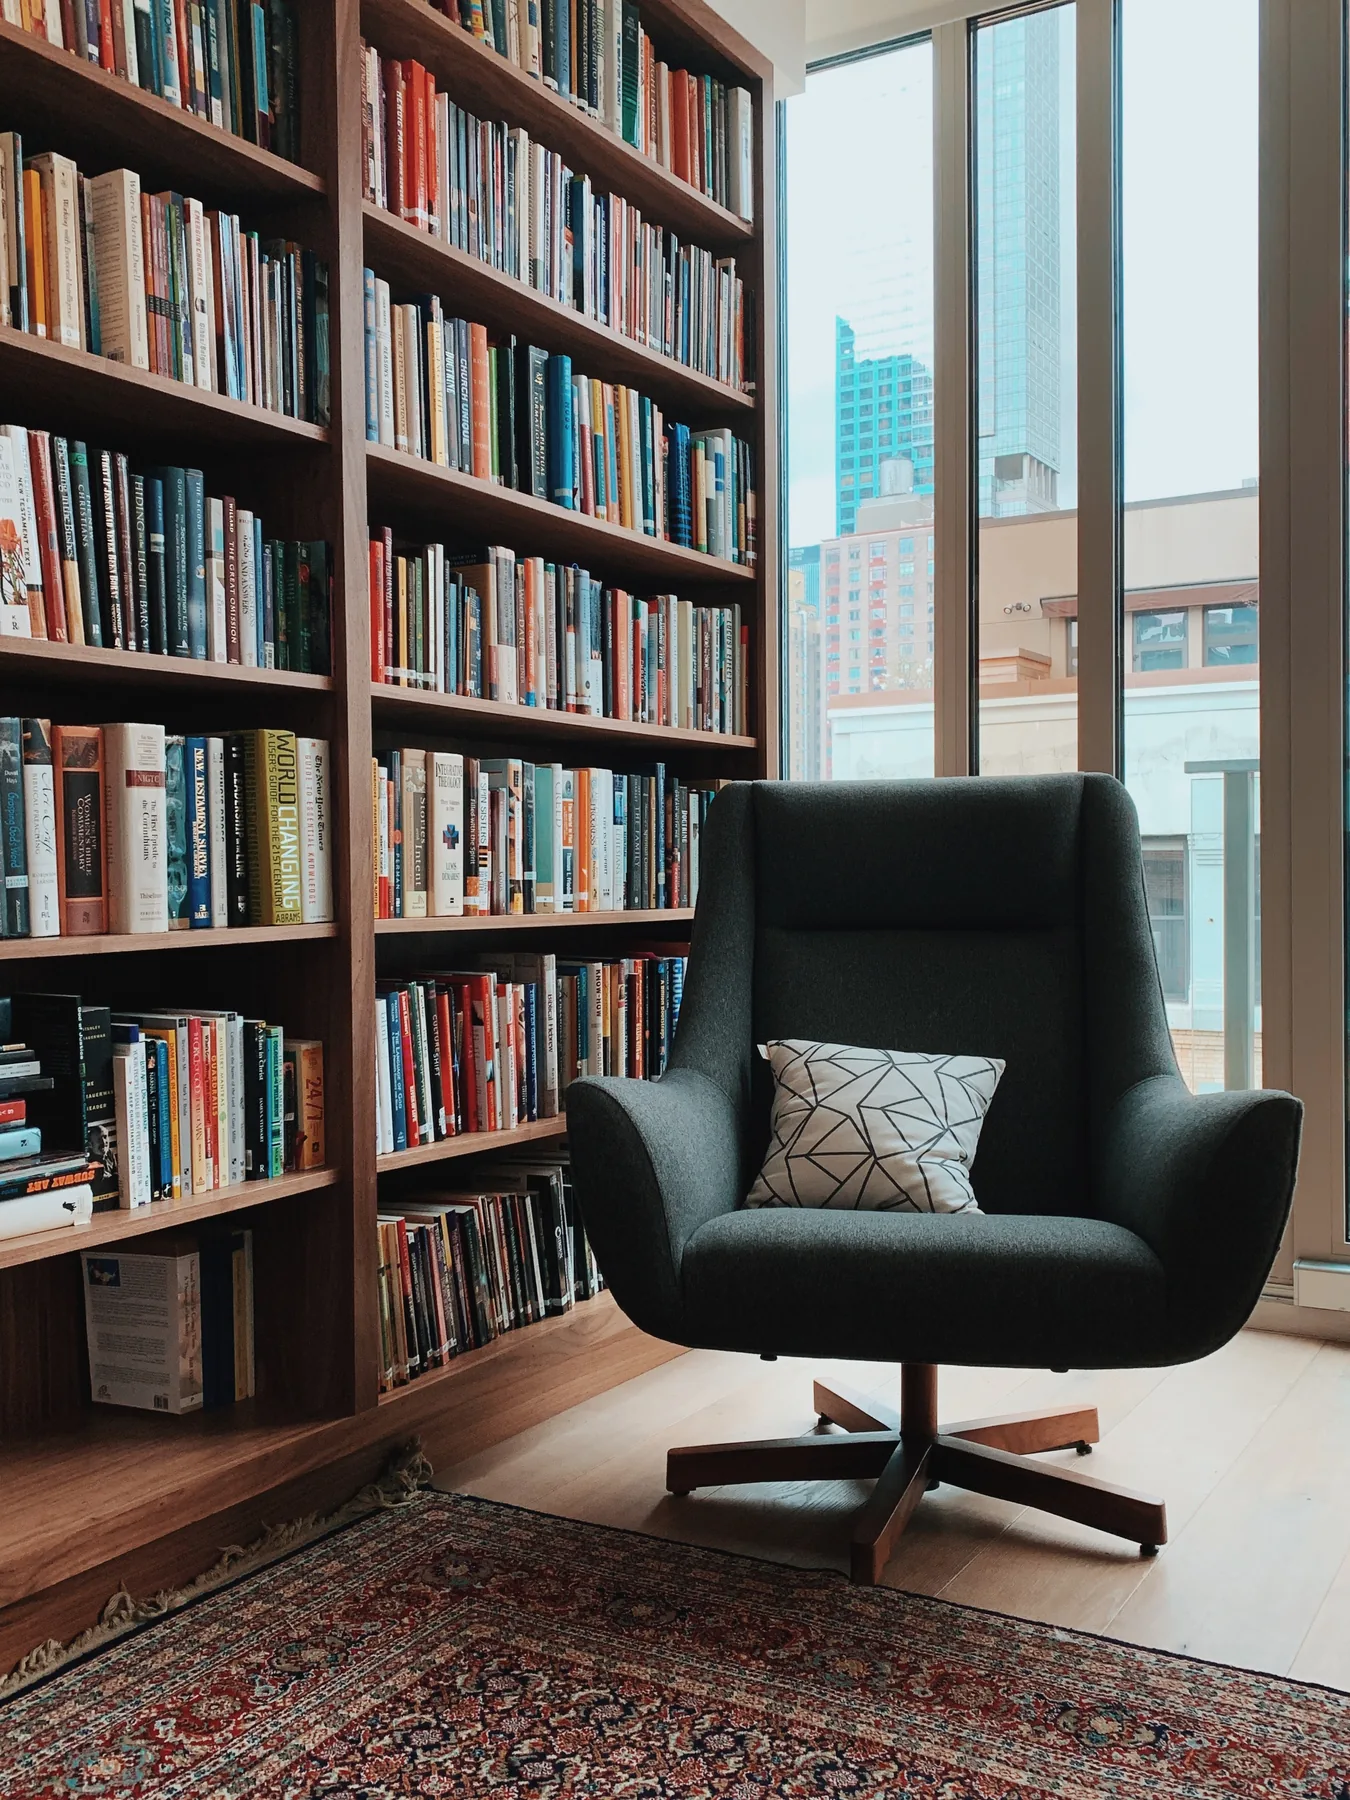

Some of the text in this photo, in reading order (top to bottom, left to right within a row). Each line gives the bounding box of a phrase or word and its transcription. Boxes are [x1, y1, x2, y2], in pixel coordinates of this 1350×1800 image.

[129, 180, 140, 282] Where Mortals Dwell
[195, 248, 203, 286] CHURCHES
[445, 351, 455, 394] DOCTRINE
[460, 358, 468, 400] CHURCH
[58, 462, 70, 492] Thing
[101, 454, 109, 475] WHAT
[62, 494, 70, 504] in
[103, 488, 112, 511] JESUS
[19, 498, 28, 543] TESTAMENT
[63, 504, 72, 523] the
[78, 484, 89, 547] CHRISTIANS
[105, 512, 114, 528] HAD
[64, 523, 75, 558] Bushes
[106, 529, 115, 553] NEVER
[108, 554, 117, 574] BEEN
[134, 481, 148, 631] HIDING LIGHT BARY
[268, 741, 277, 772] USER'S
[315, 755, 323, 772] The
[435, 761, 463, 777] INTEGRATIVE
[32, 773, 40, 808] BIBLICAL
[138, 774, 161, 783] NIGTC
[269, 776, 278, 802] GUIDE
[315, 775, 323, 794] New
[438, 774, 461, 788] THEOLOGY
[6, 792, 19, 825] Grasping
[84, 793, 92, 844] WOMEN'S
[194, 748, 208, 878] NEW TESTAMENT SURVEY
[271, 805, 279, 822] FOR
[315, 797, 325, 820] York
[419, 797, 427, 844] Stories
[76, 797, 86, 871] COMMENTARY
[143, 812, 151, 861] Corinthians
[233, 772, 245, 878] LEADERSHIP LINE
[272, 825, 280, 842] THE
[304, 755, 316, 904] GUIDE TO ESSENTIAL KNOWLEDGE
[10, 848, 20, 869] Word
[151, 834, 159, 860] Epistle
[272, 845, 281, 866] 21ST
[415, 844, 423, 886] Intent
[274, 868, 283, 908] CENTURY
[276, 914, 301, 923] ABRAMS
[259, 1051, 265, 1059] in
[306, 1077, 323, 1120] 24/7
[26, 1179, 51, 1194] ART
[51, 1170, 96, 1189] SUBWAY
